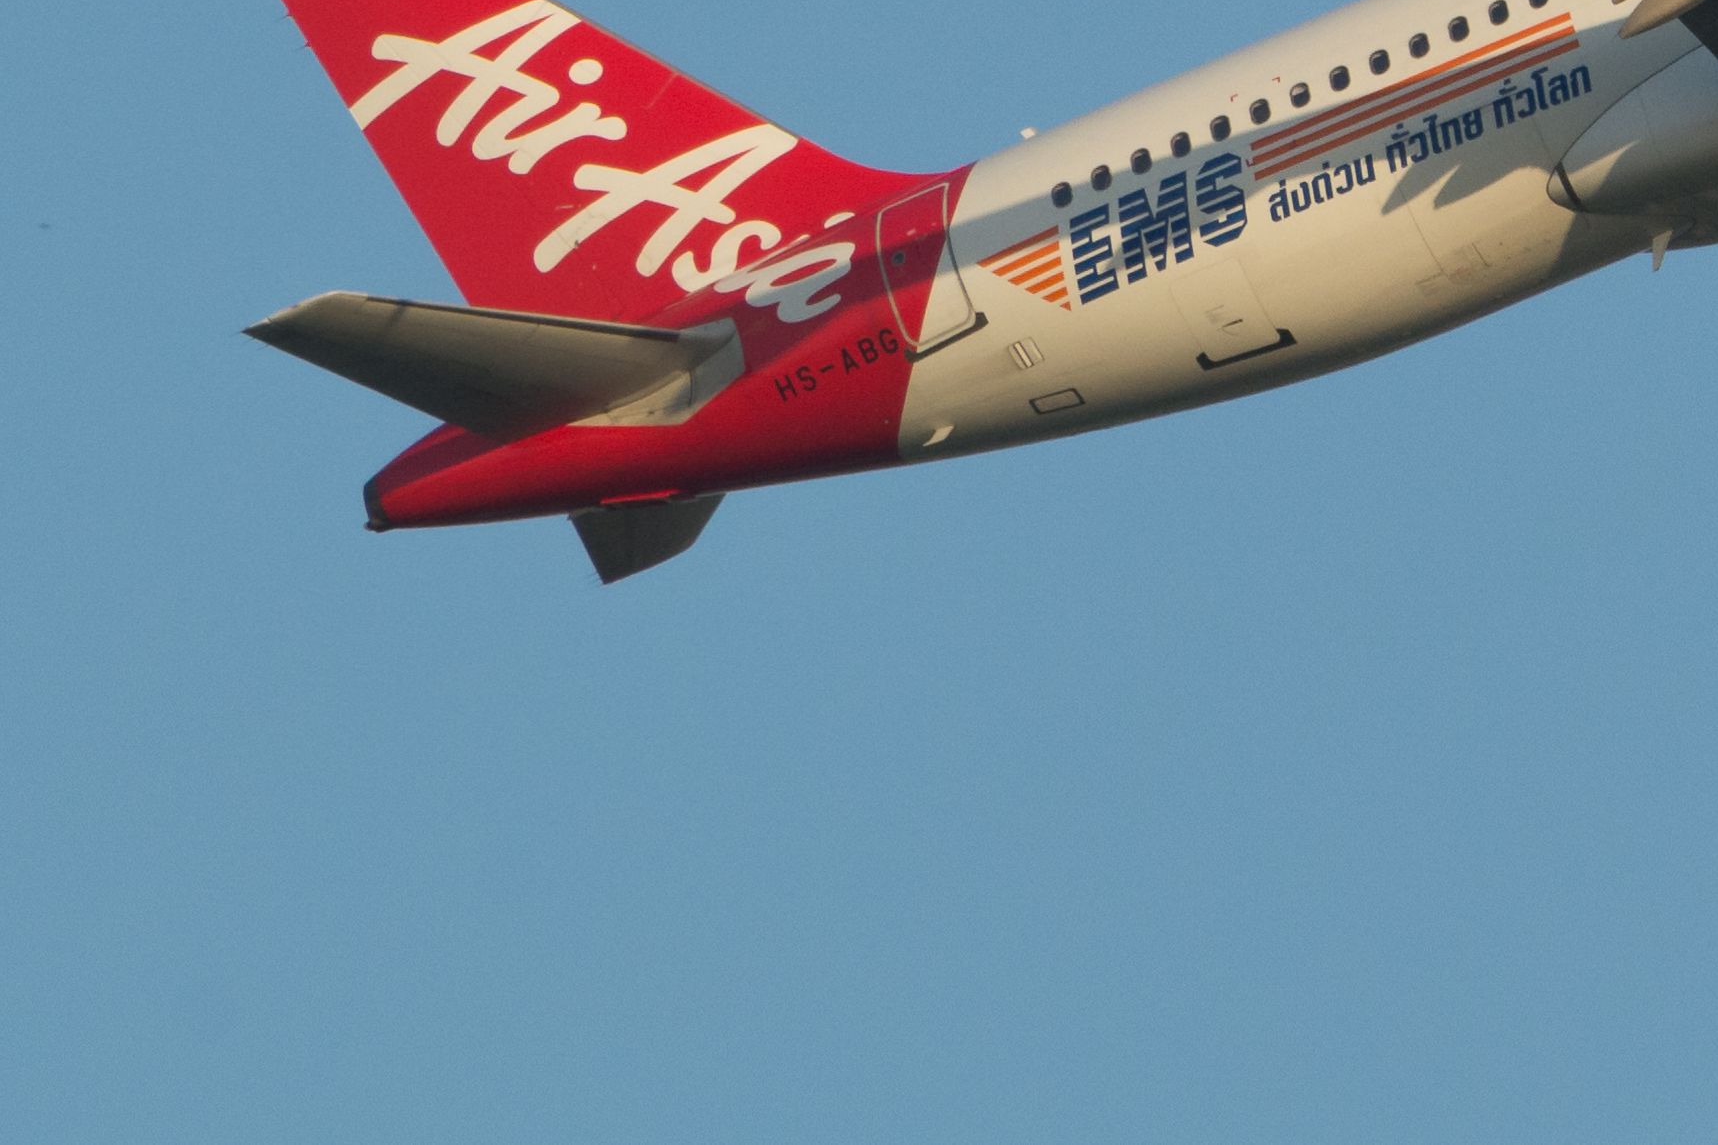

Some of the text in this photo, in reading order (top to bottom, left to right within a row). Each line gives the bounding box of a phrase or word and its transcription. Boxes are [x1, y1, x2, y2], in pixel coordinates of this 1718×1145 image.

[1267, 64, 1592, 223] ส่งด่วน ทั่วไทย ทั่วโลก
[1069, 152, 1248, 306] EMS
[774, 328, 899, 402] HS-ABG
